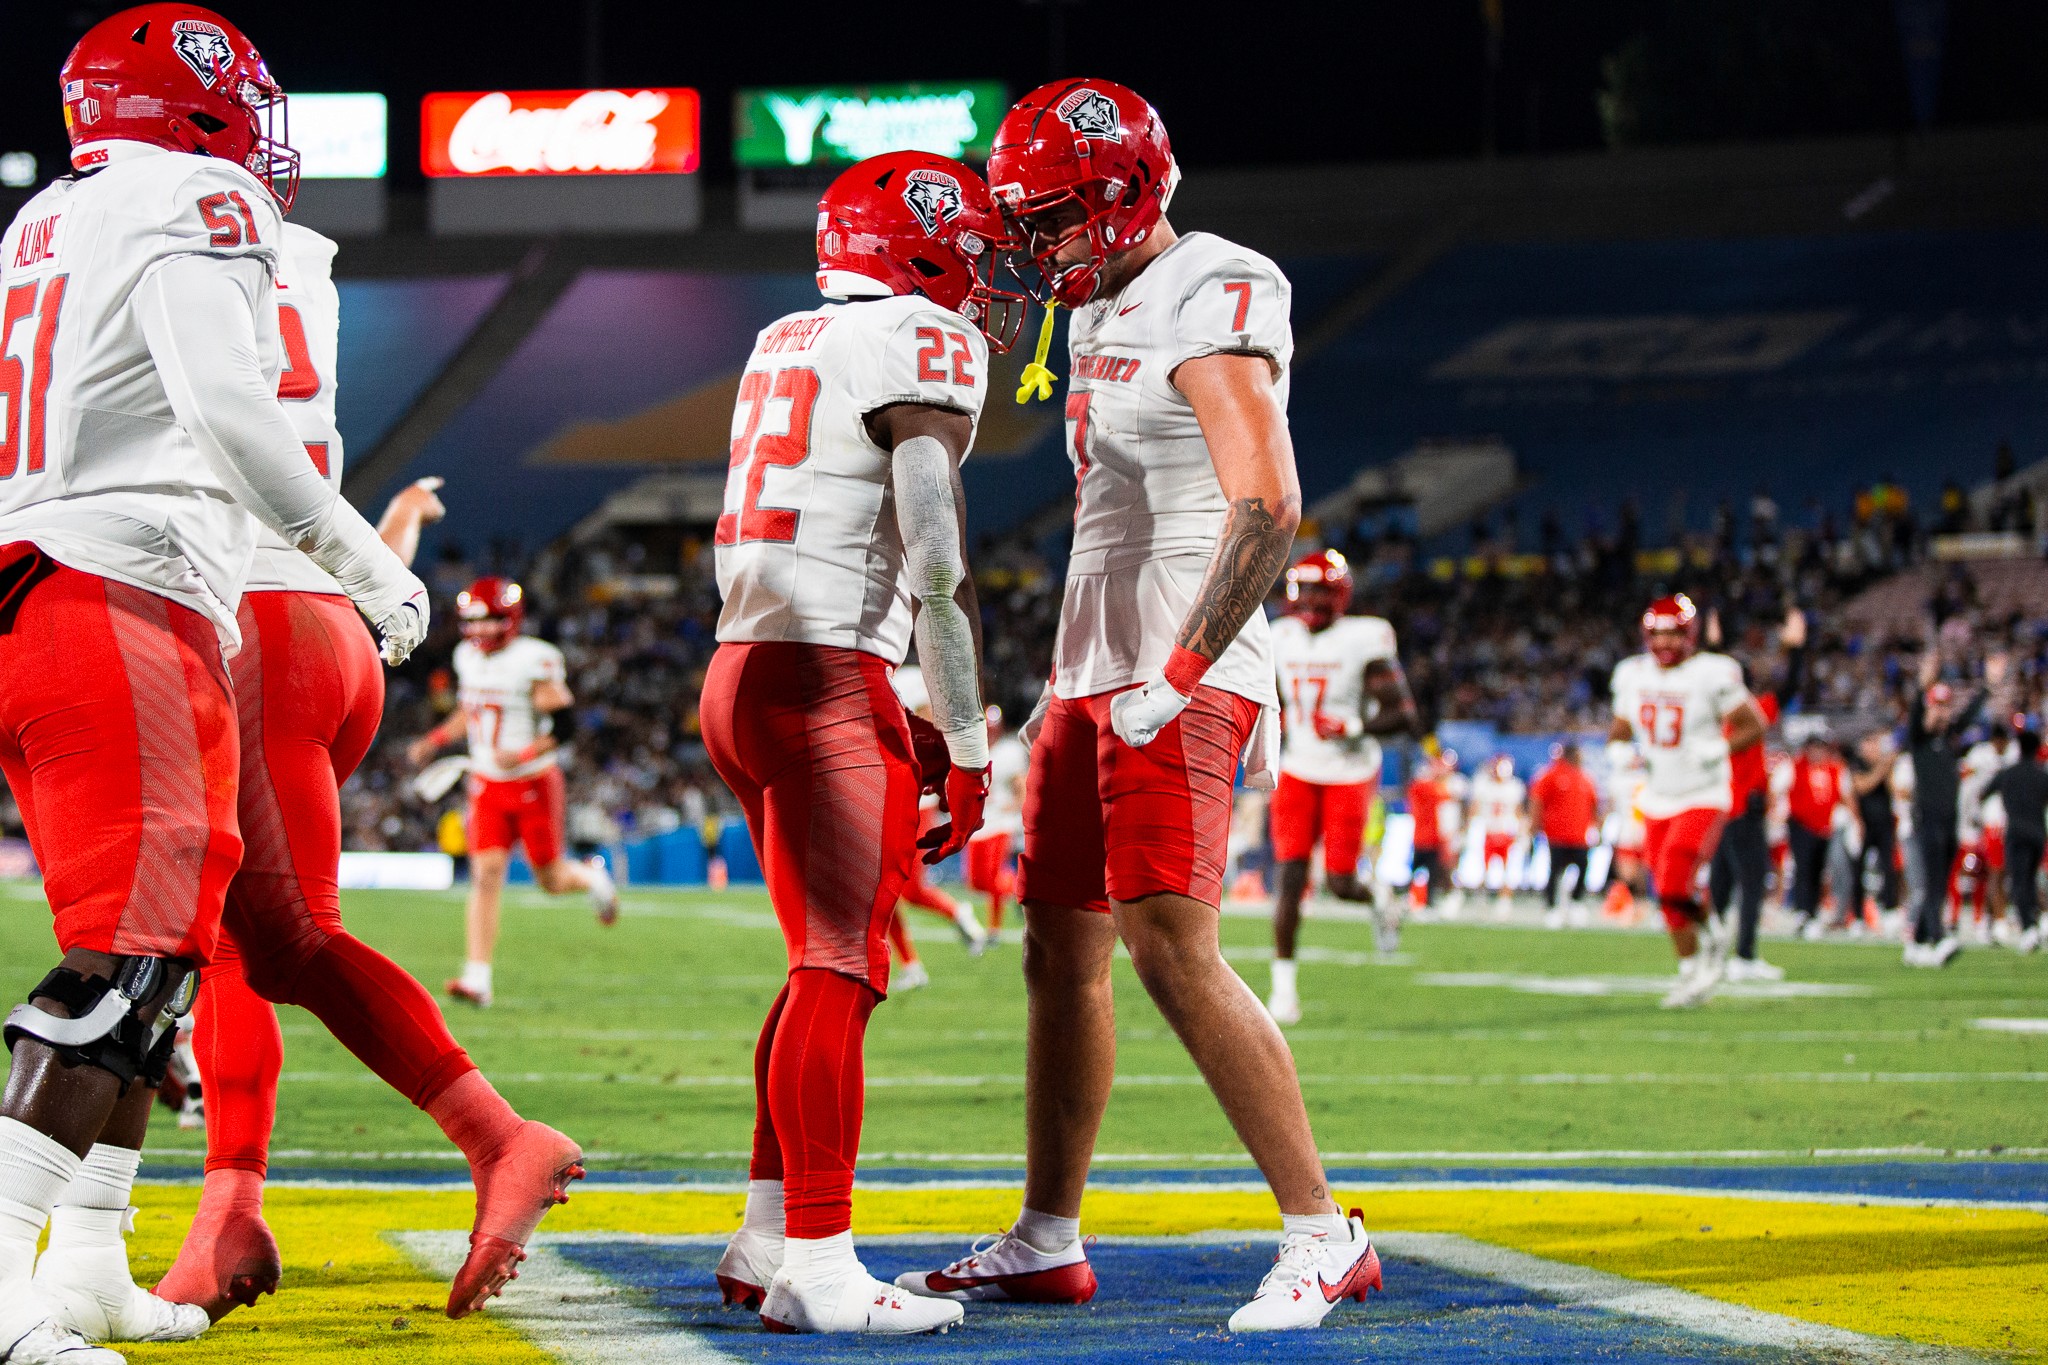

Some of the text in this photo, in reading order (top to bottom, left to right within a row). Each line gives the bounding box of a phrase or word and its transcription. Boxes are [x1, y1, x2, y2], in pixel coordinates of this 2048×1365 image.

[175, 21, 224, 36] LOBOS
[911, 170, 959, 188] LOBOS
[196, 190, 261, 247] 51
[1224, 281, 1252, 333] 7
[0, 273, 70, 480] 51
[915, 326, 976, 388] 22
[1077, 354, 1142, 383] MEXICO
[714, 365, 822, 550] 22
[1064, 389, 1094, 534] 7
[1639, 702, 1684, 749] 93
